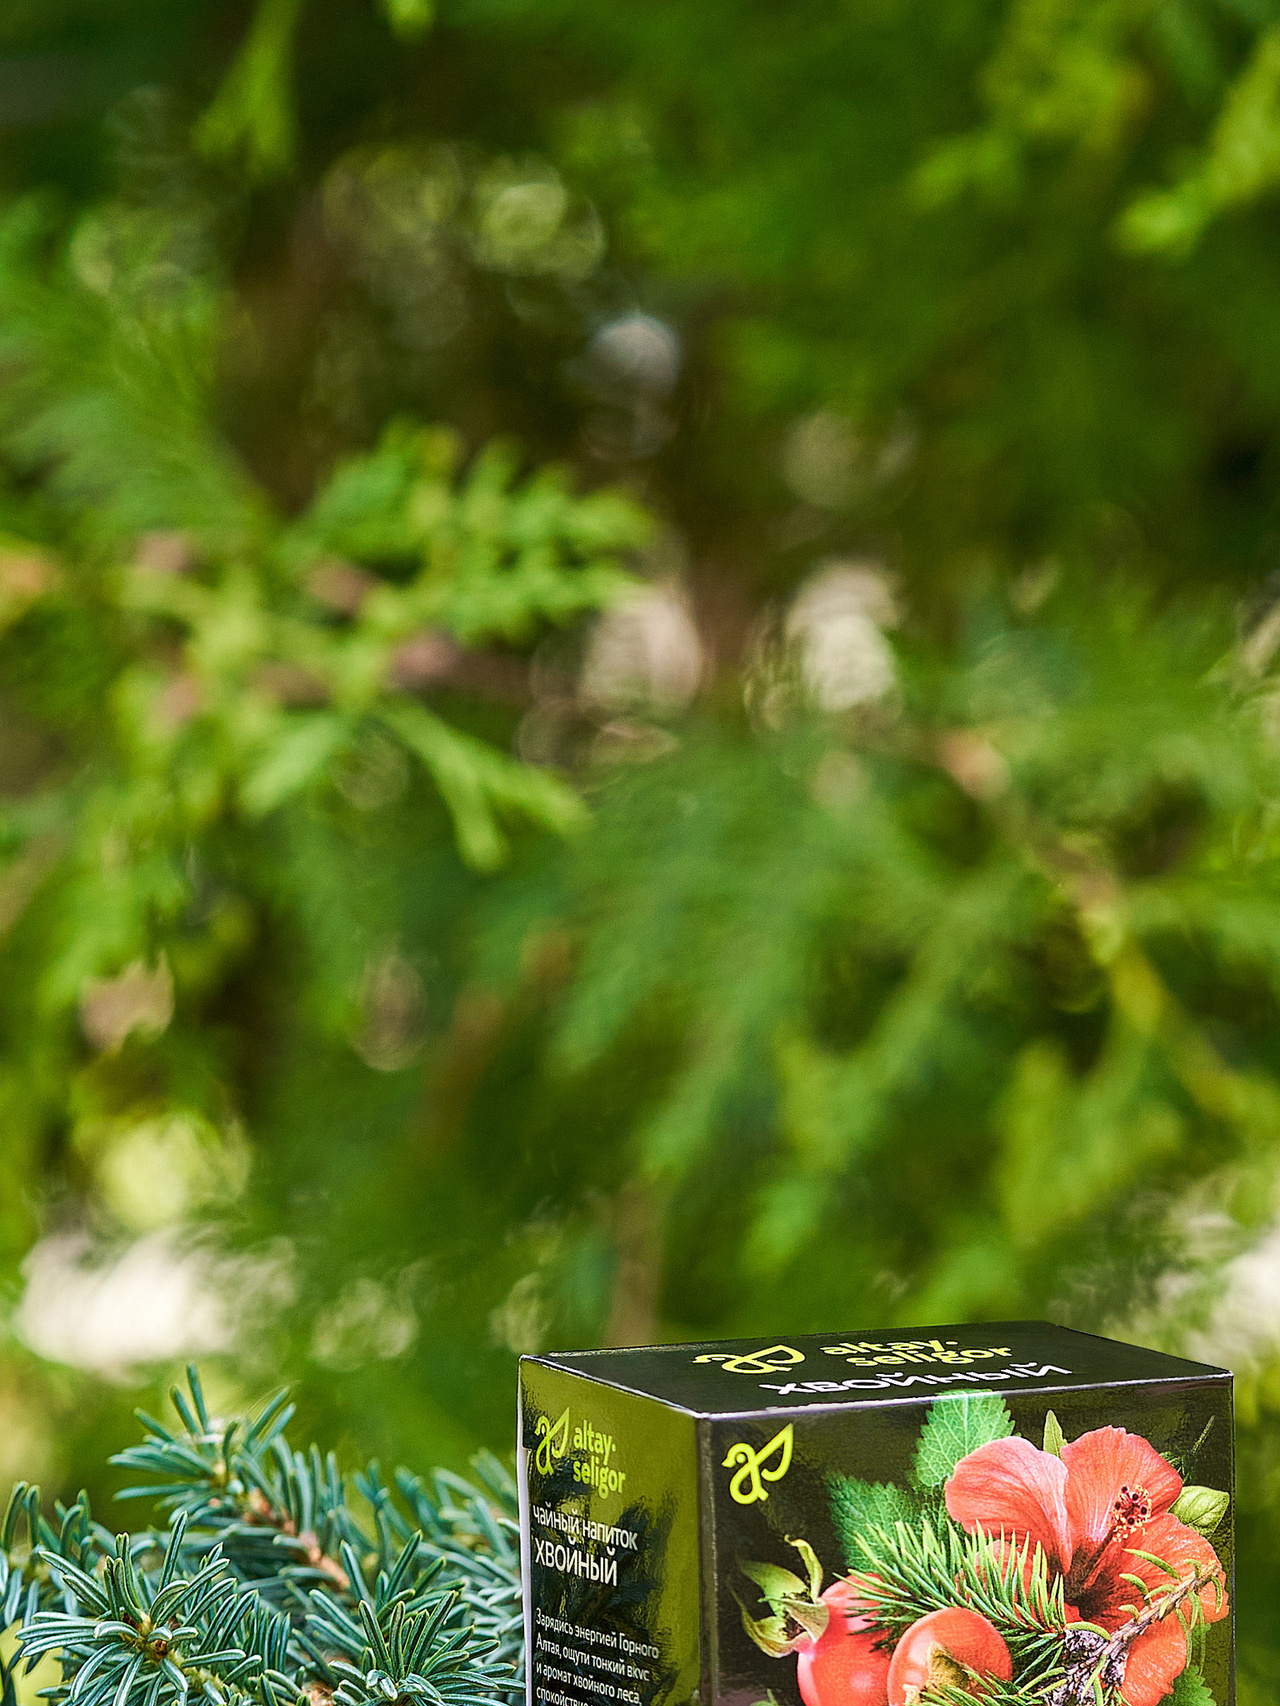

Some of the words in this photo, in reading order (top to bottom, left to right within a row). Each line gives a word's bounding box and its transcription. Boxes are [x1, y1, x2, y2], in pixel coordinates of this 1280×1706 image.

[845, 1345, 1013, 1366] seligor
[572, 1455, 626, 1499] seligor
[532, 1501, 579, 1534] чайный
[582, 1519, 638, 1551] напиток
[535, 1535, 618, 1586] ХВОЙНЫЙ
[536, 1607, 574, 1635] Зарядись
[574, 1625, 617, 1648] энергией
[619, 1633, 659, 1659] Горного
[536, 1632, 562, 1659] Алтая,
[562, 1646, 590, 1666] ощути
[591, 1655, 625, 1675] тонкий
[627, 1665, 650, 1681] вкус
[536, 1662, 542, 1674] и
[543, 1664, 572, 1684] аромат
[573, 1674, 615, 1698] хвойного
